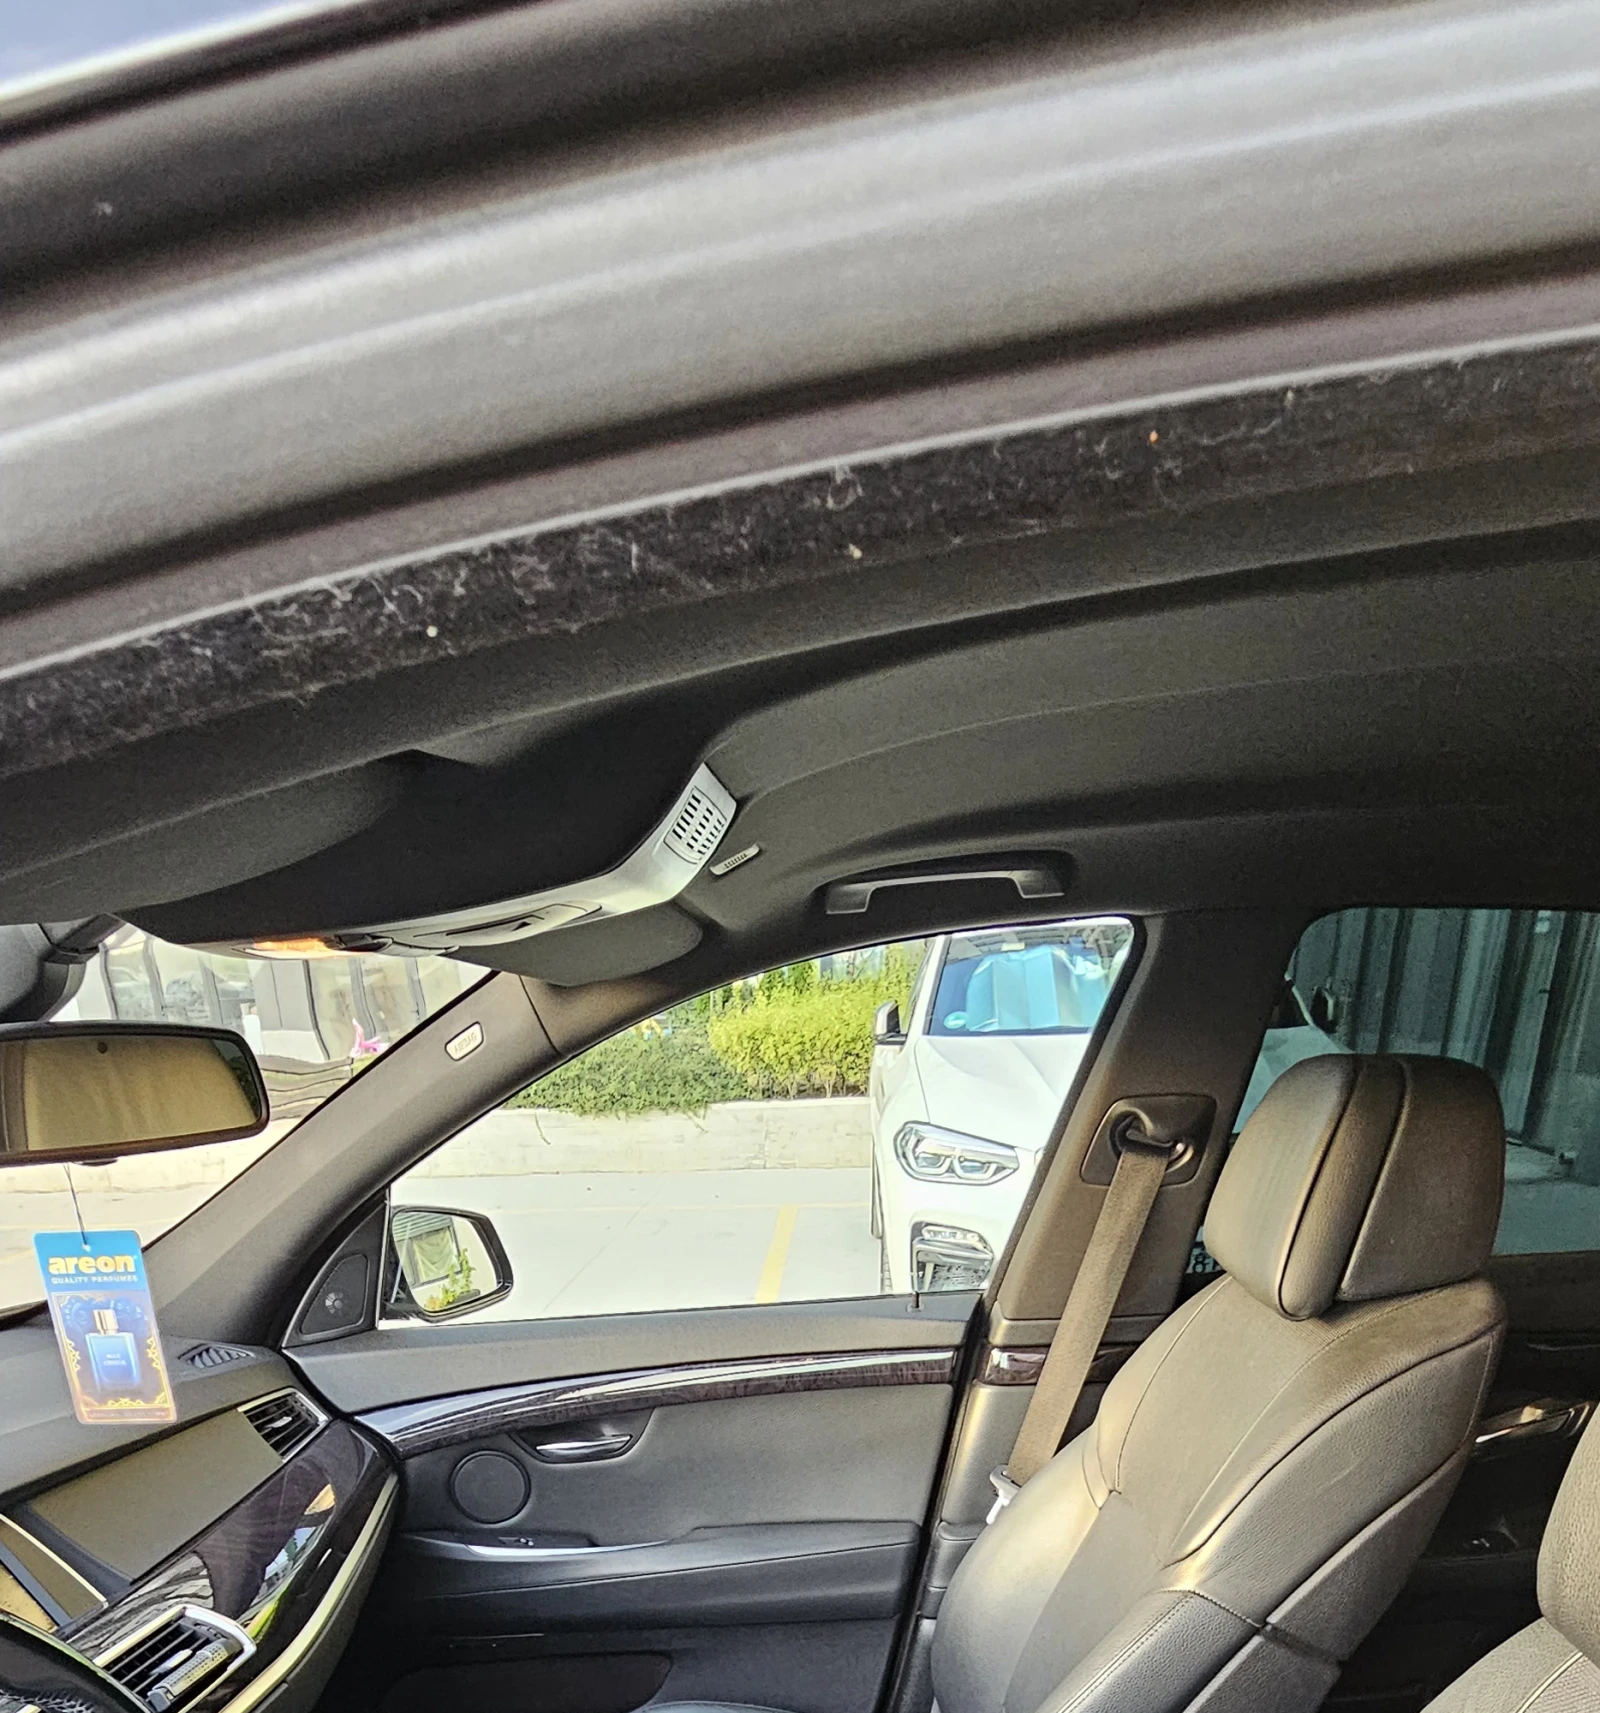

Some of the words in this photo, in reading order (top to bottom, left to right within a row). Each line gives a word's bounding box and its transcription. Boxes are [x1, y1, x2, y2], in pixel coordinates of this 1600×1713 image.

[48, 1255, 136, 1274] areon
[51, 1276, 90, 1285] QUALITY
[91, 1274, 138, 1283] PERFUMES
